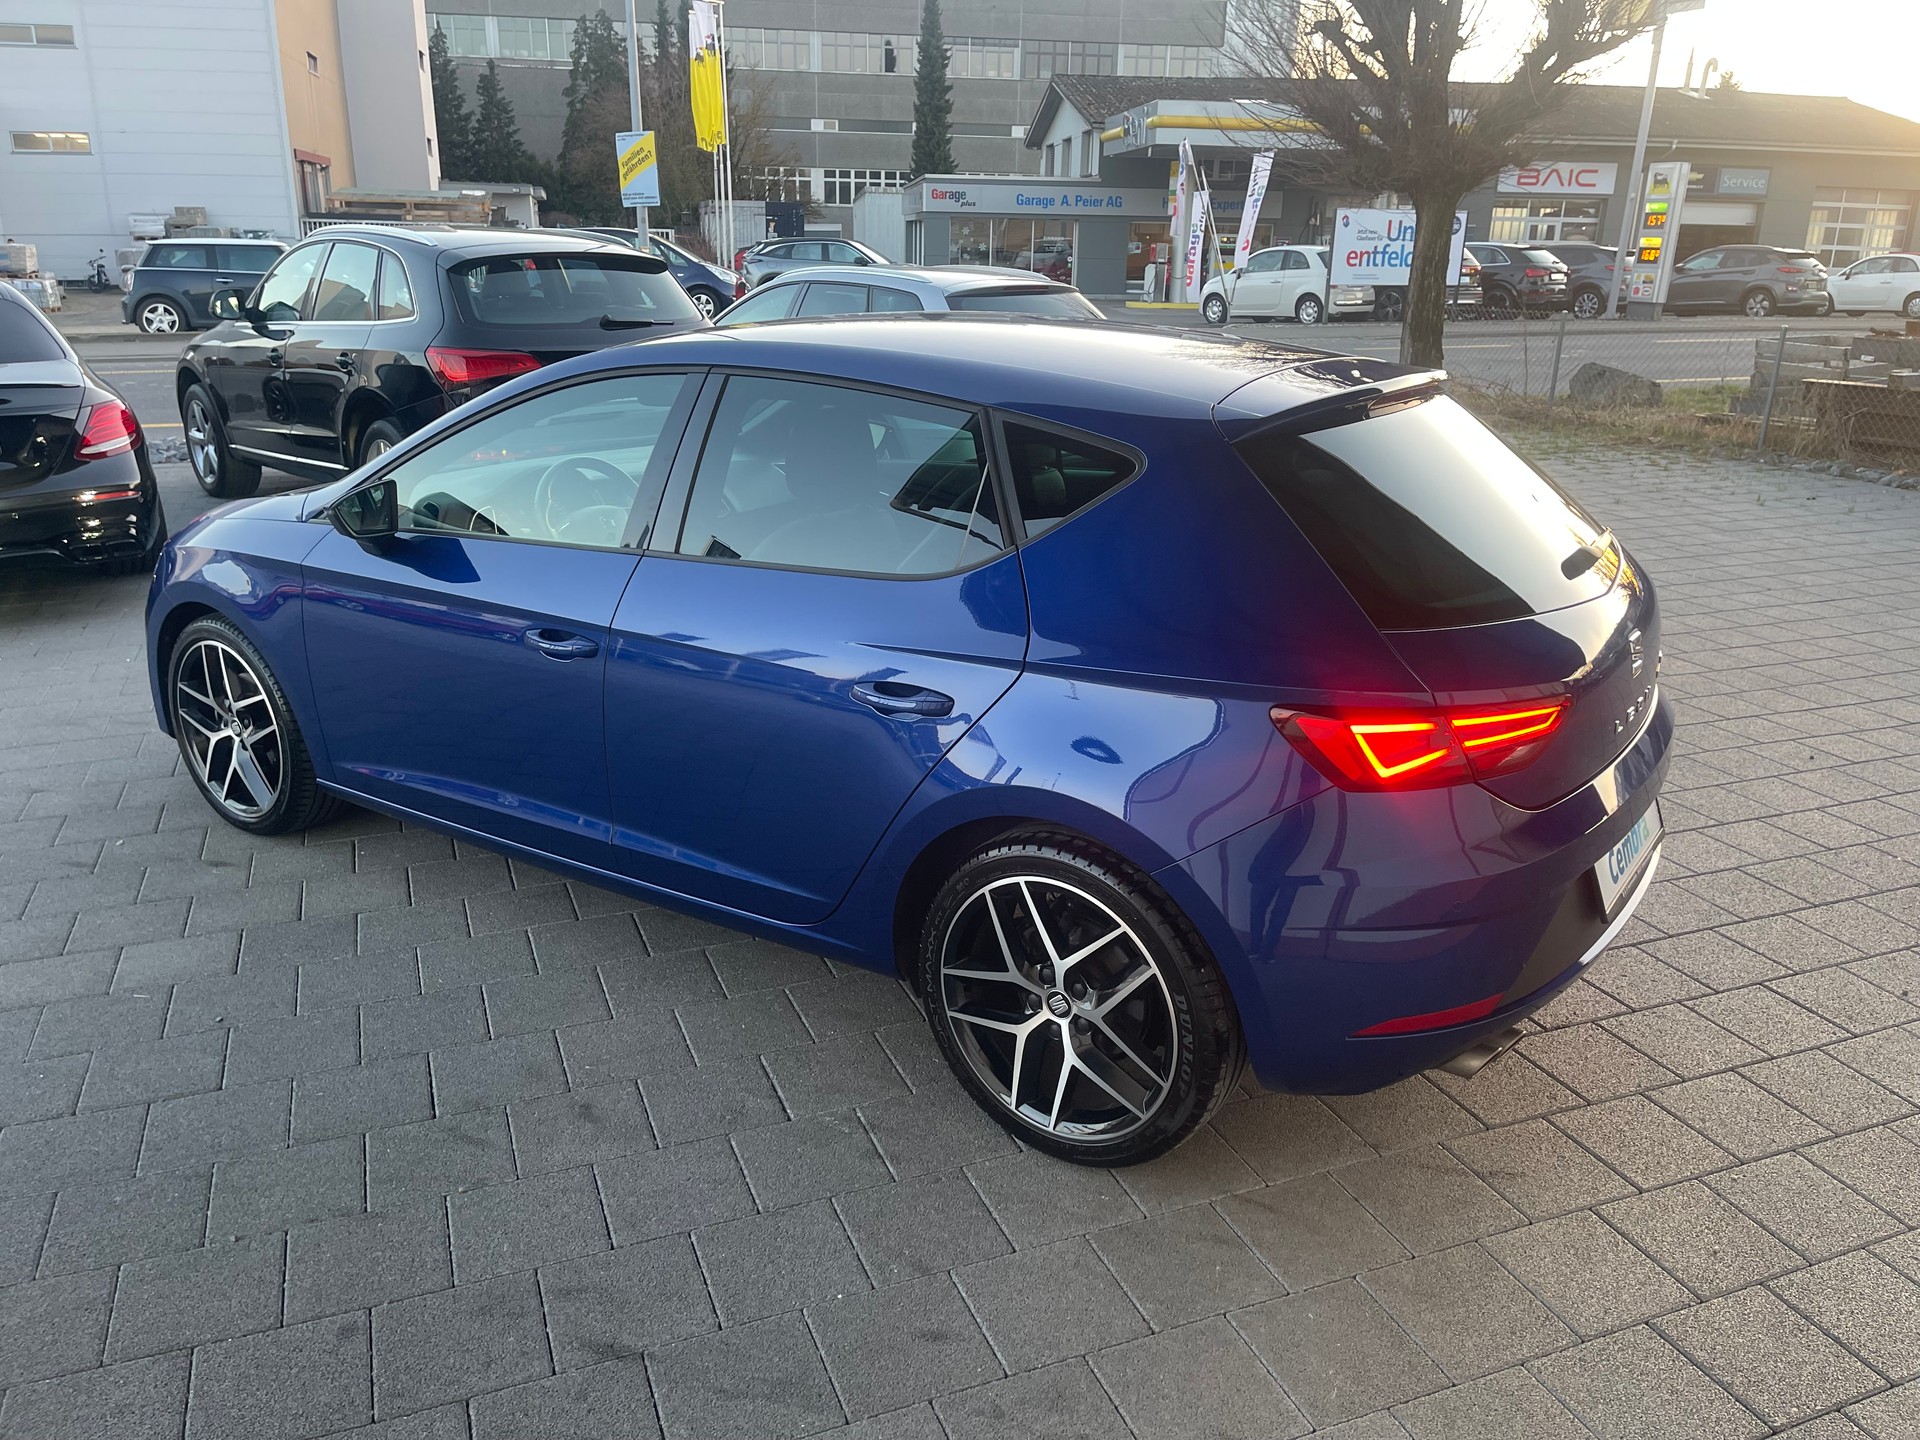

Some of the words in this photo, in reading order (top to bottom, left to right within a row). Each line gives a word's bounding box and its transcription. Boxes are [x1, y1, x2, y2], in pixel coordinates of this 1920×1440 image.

[621, 147, 645, 169] Familien
[622, 150, 653, 181] gefährden?
[1517, 168, 1599, 187] BAIC
[1722, 175, 1766, 189] Service
[931, 188, 967, 203] Garage
[960, 200, 976, 208] plus
[1016, 193, 1055, 209] Garage
[1060, 194, 1071, 207] A.
[1075, 195, 1104, 208] Peier
[1106, 196, 1123, 208] AG
[1172, 991, 1194, 1099] DUNLOP
